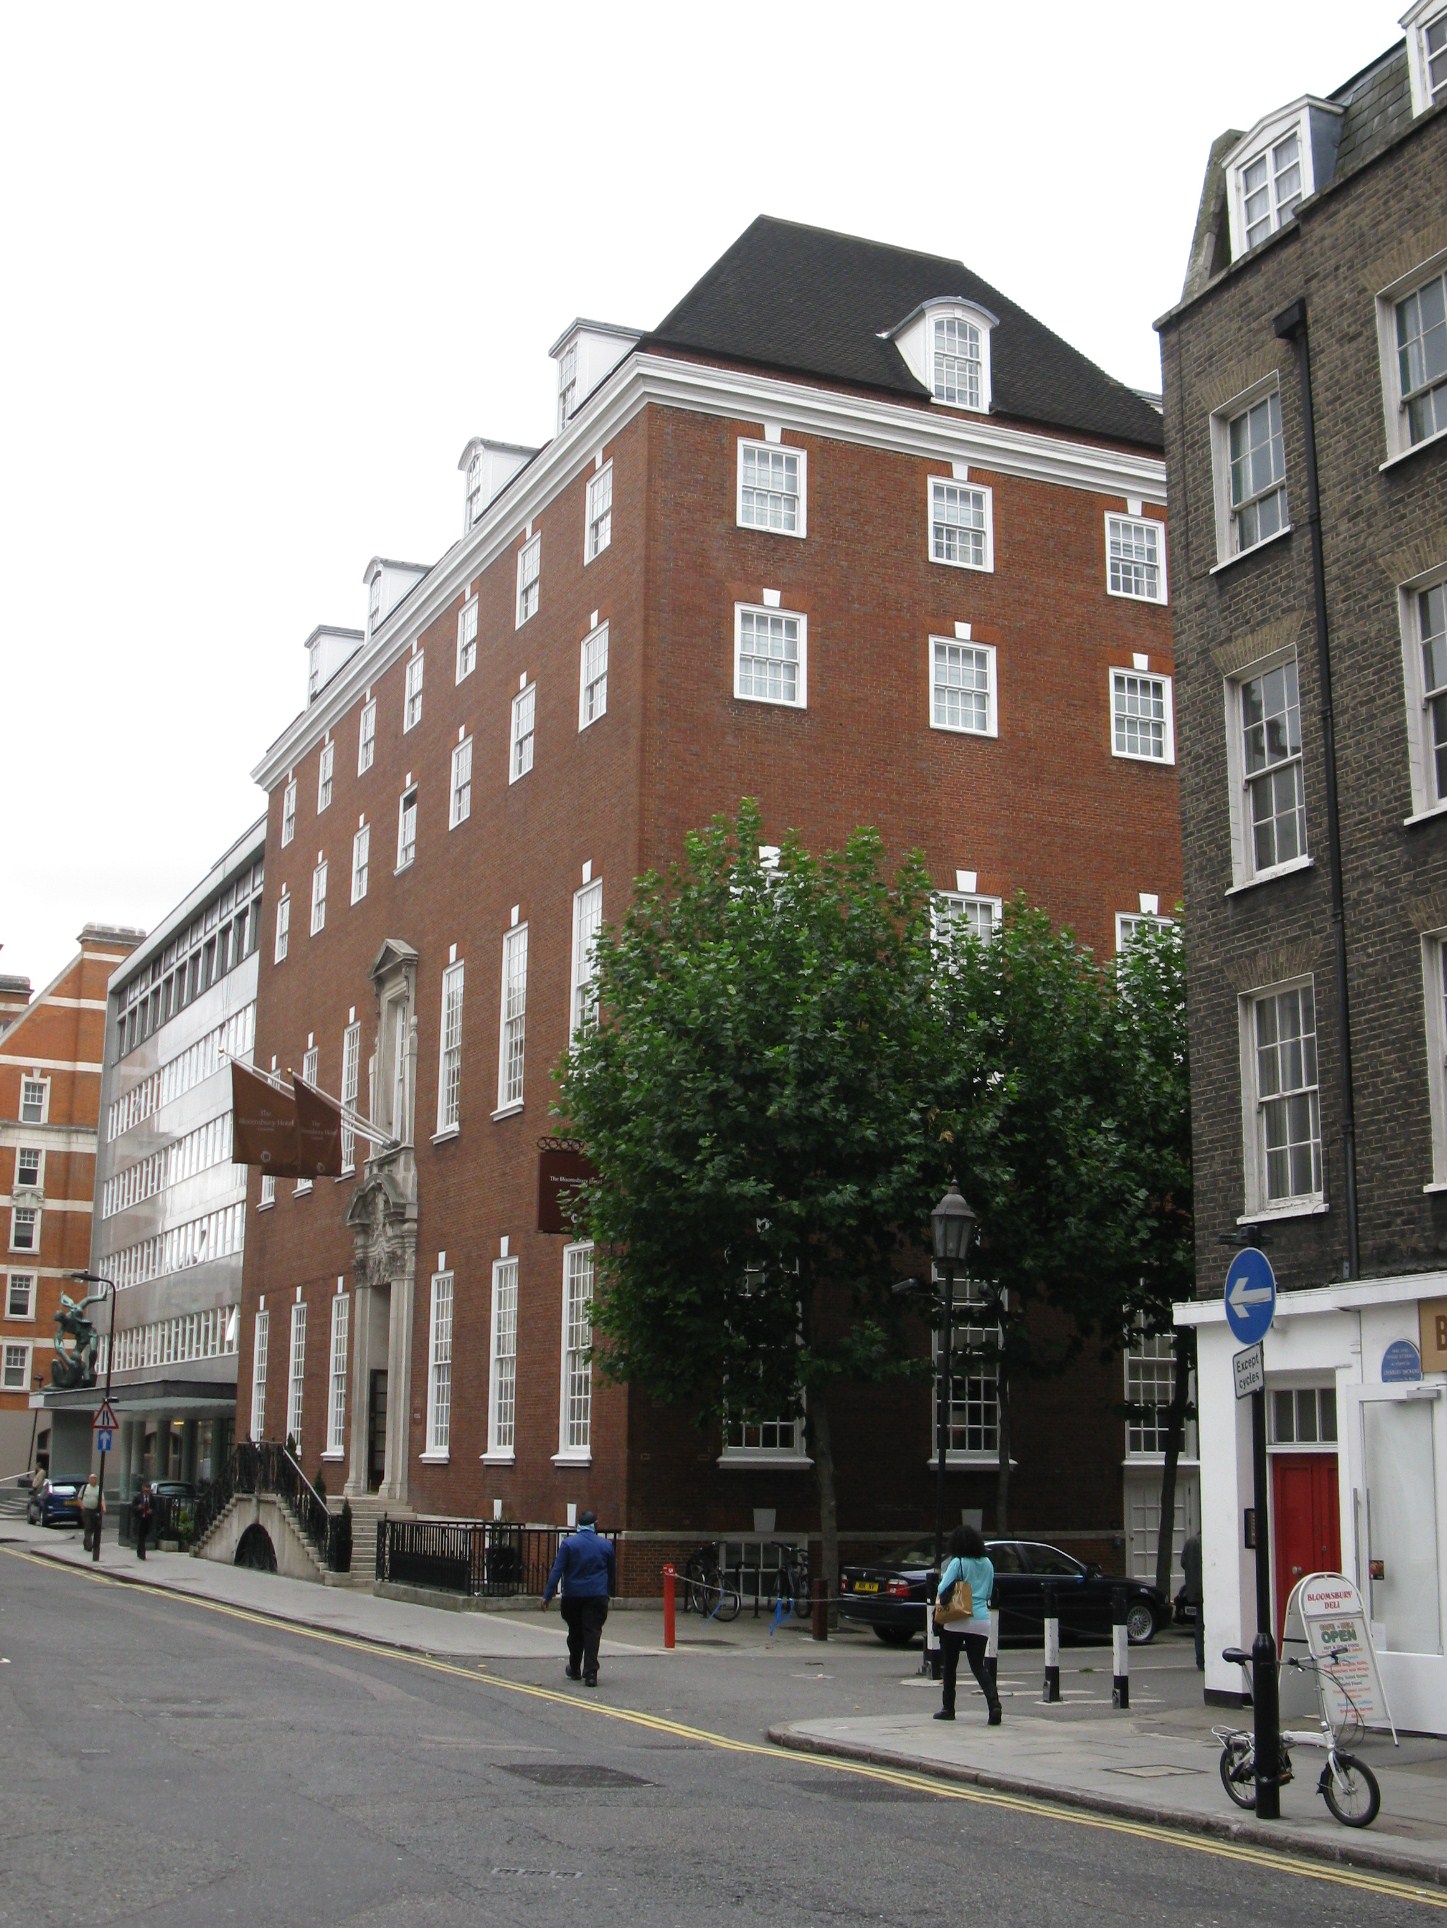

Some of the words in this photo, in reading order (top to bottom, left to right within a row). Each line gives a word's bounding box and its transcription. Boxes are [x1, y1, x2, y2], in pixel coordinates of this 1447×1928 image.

[1236, 1353, 1259, 1373] Except
[1239, 1371, 1259, 1389] cycles
[1307, 1591, 1352, 1601] BLOOMSBURY
[1324, 1601, 1340, 1609] DELI
[1321, 1629, 1357, 1643] OPEN
